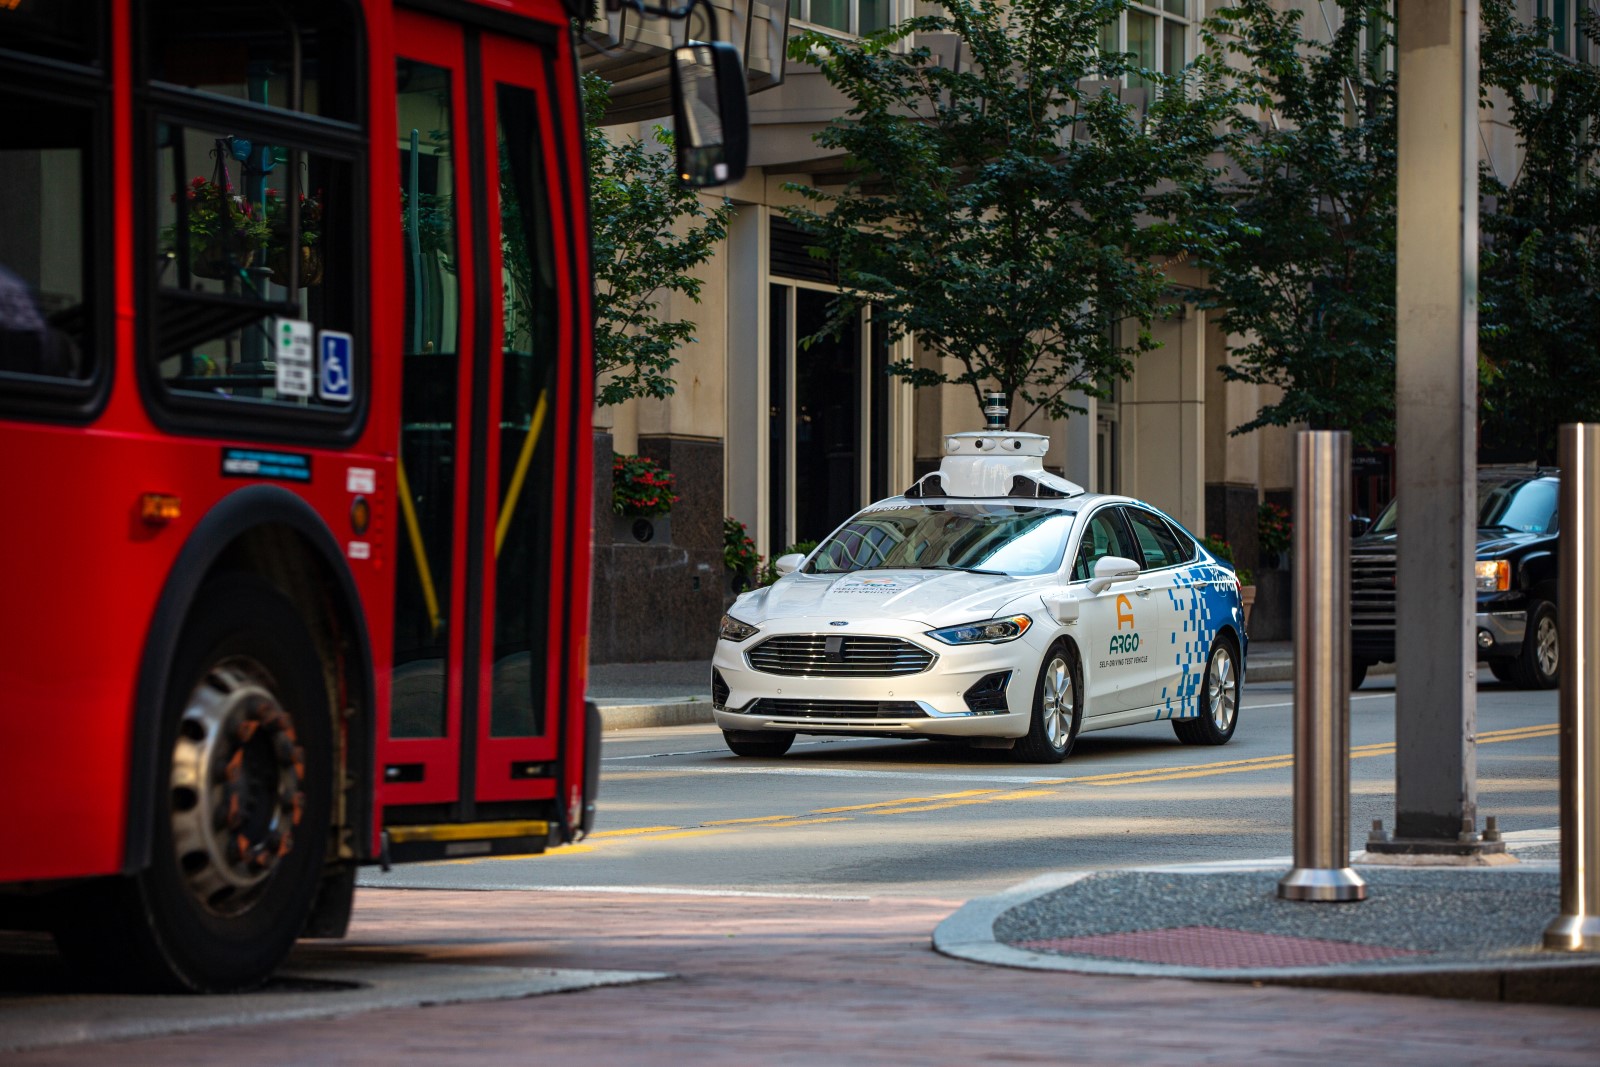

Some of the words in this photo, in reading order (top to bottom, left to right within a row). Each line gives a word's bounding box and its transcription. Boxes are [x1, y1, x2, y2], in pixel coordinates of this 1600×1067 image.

[1109, 632, 1140, 655] ARGO
[1099, 658, 1124, 669] SELF-DRIVING
[1125, 657, 1133, 665] TEST
[1134, 655, 1148, 664] VEHICLE
